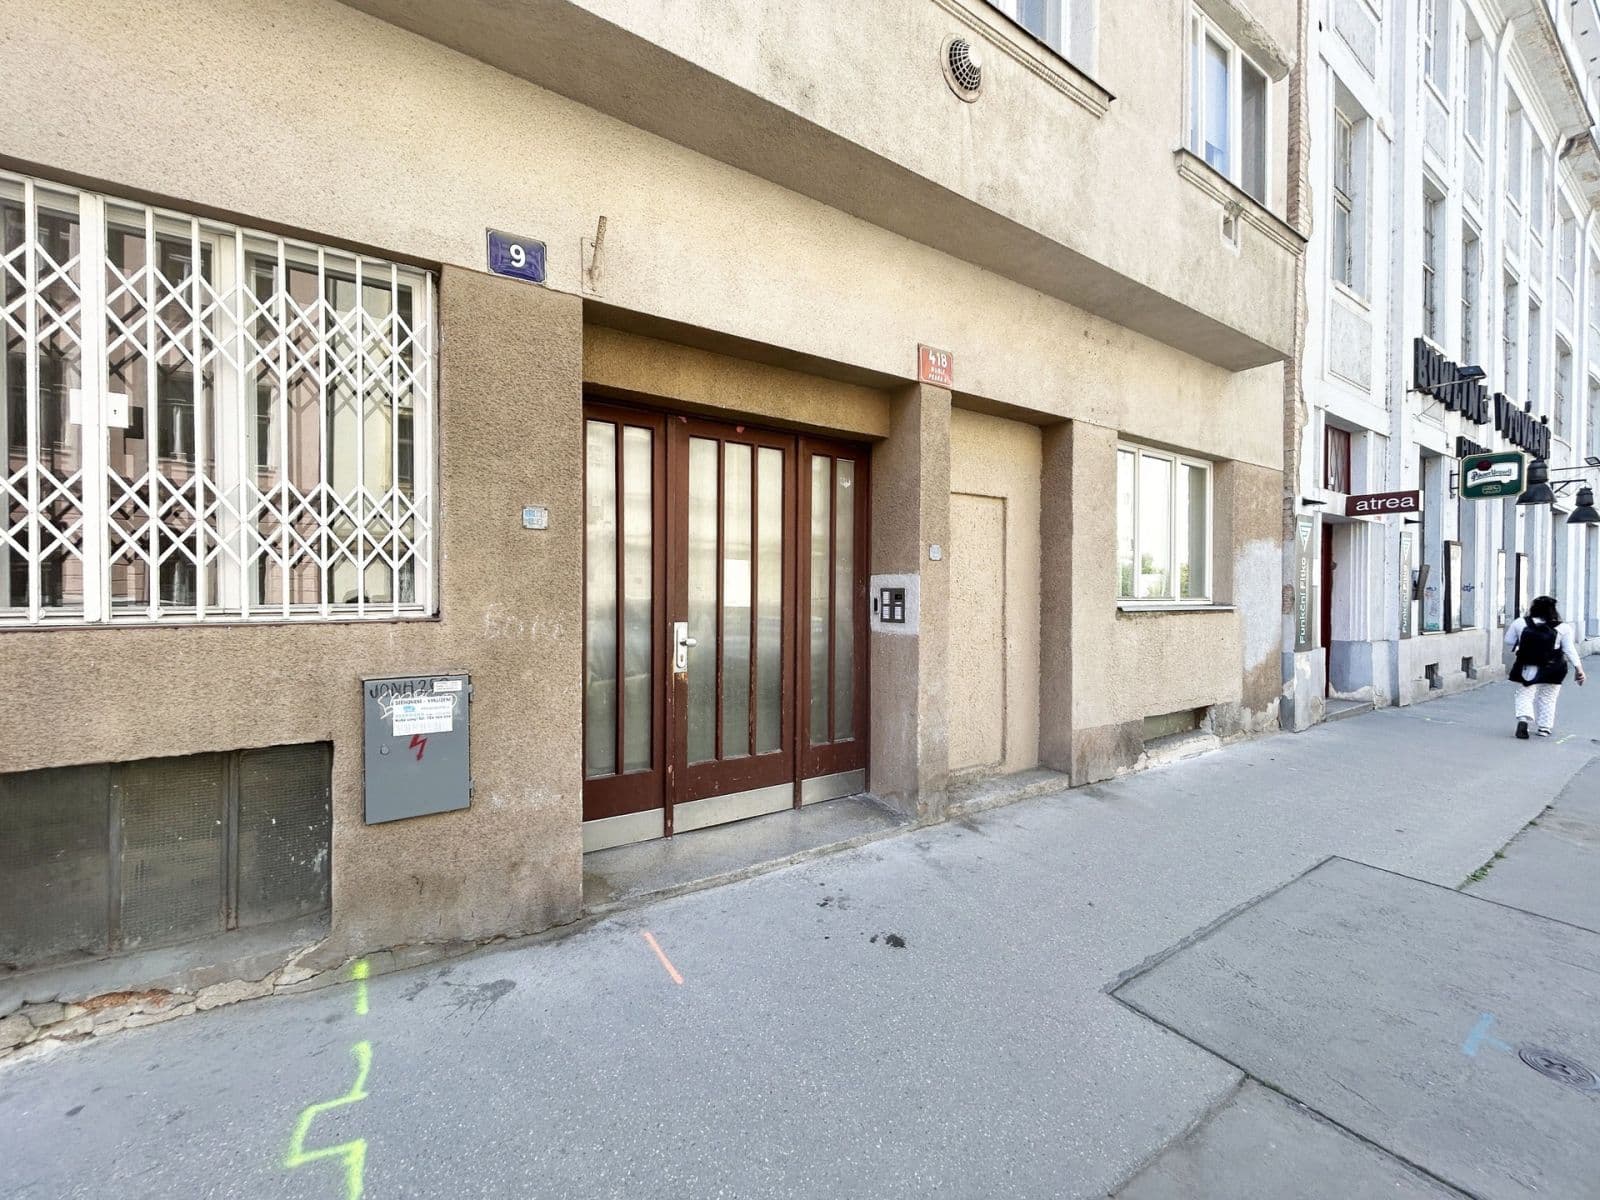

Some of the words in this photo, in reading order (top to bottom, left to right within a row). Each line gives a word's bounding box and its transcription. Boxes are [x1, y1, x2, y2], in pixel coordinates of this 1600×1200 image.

[510, 244, 526, 268] 9
[929, 350, 948, 368] 418
[1414, 338, 1489, 425] BOWLING
[1356, 496, 1415, 511] atrea
[1299, 592, 1307, 644] Funkční
